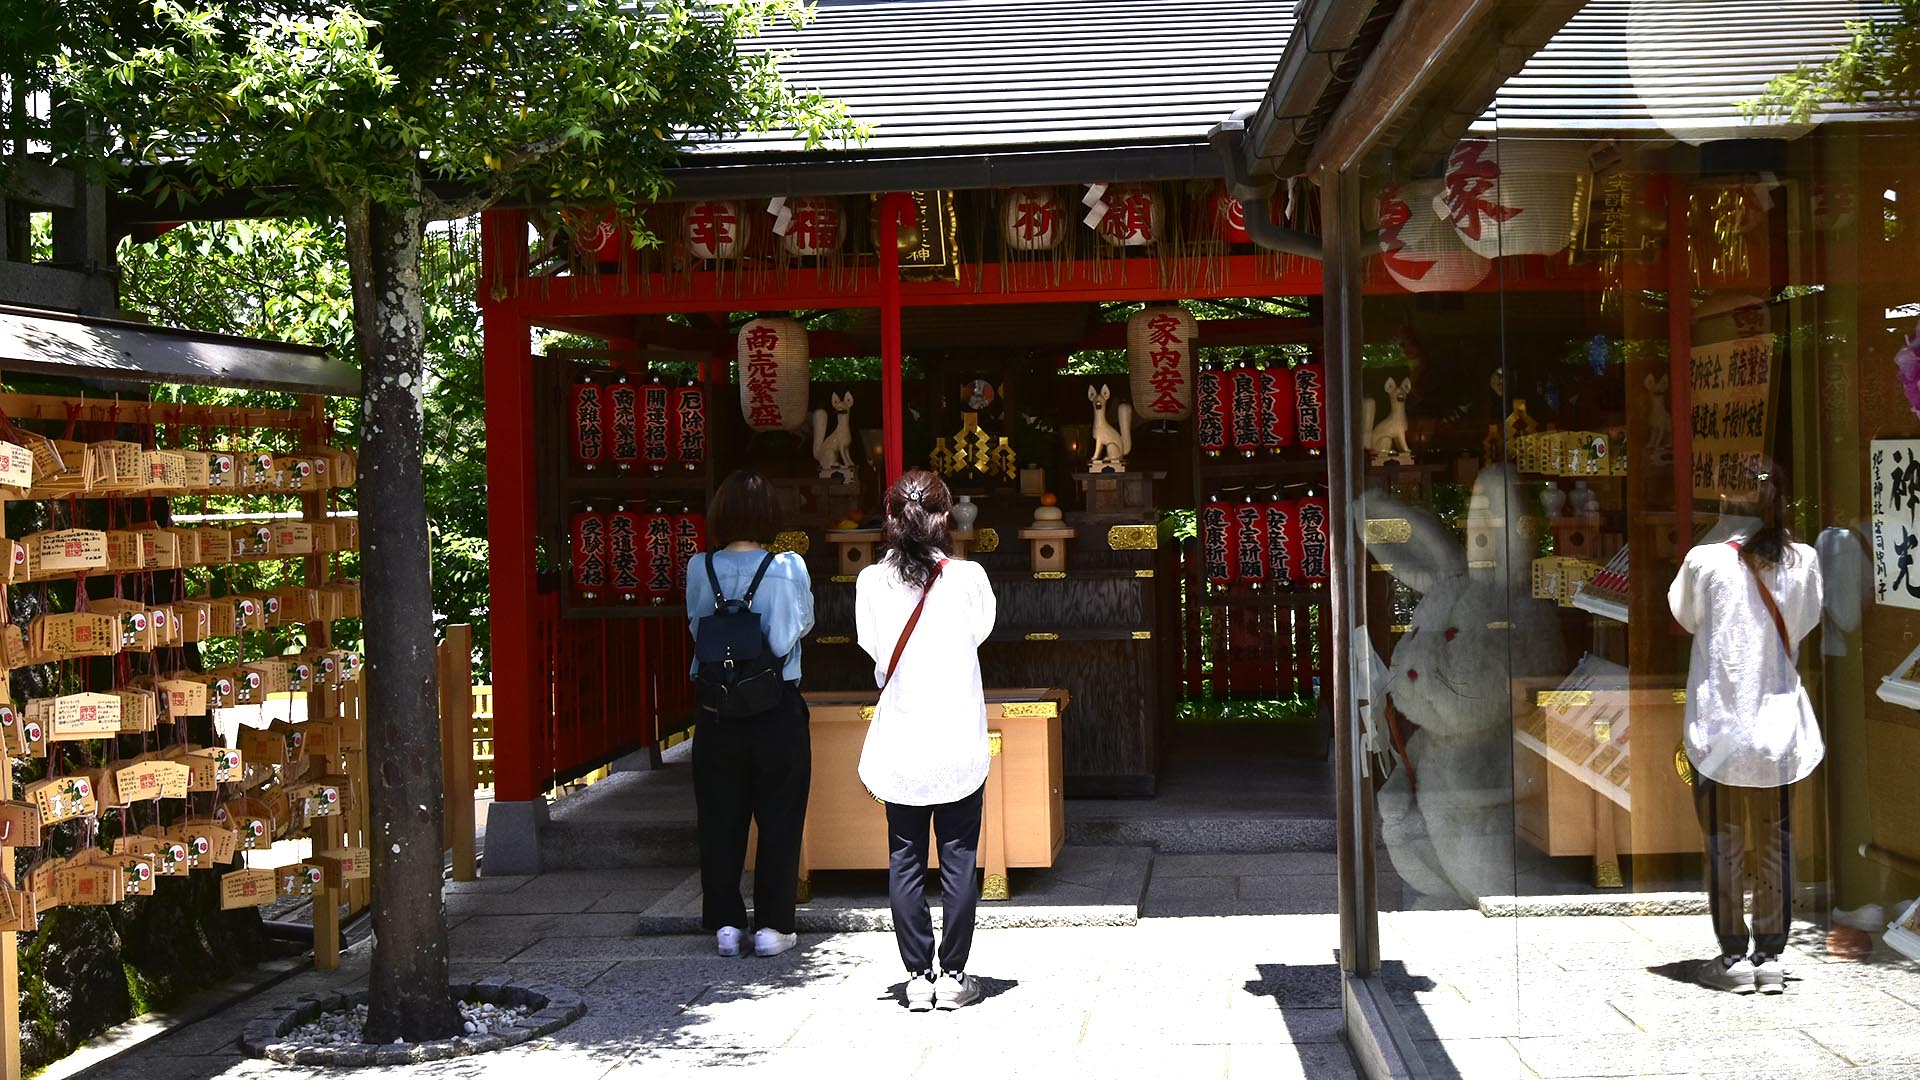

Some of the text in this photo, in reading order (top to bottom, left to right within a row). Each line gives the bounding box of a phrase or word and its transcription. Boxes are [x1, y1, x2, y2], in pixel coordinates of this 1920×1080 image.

[687, 201, 737, 254] 幸
[785, 199, 838, 250] 福
[1012, 191, 1066, 241] 祈
[746, 326, 782, 426] 商売繁盛
[1147, 314, 1186, 414] 家内安全
[613, 388, 637, 460] 商売繁盛
[645, 388, 668, 460] 開運招福
[578, 516, 605, 586] 受験合格
[609, 515, 640, 589] 交通安全
[1204, 507, 1230, 579] 健康祈願
[1236, 507, 1263, 578] 子宝祈願
[1300, 504, 1328, 578] 病気回復
